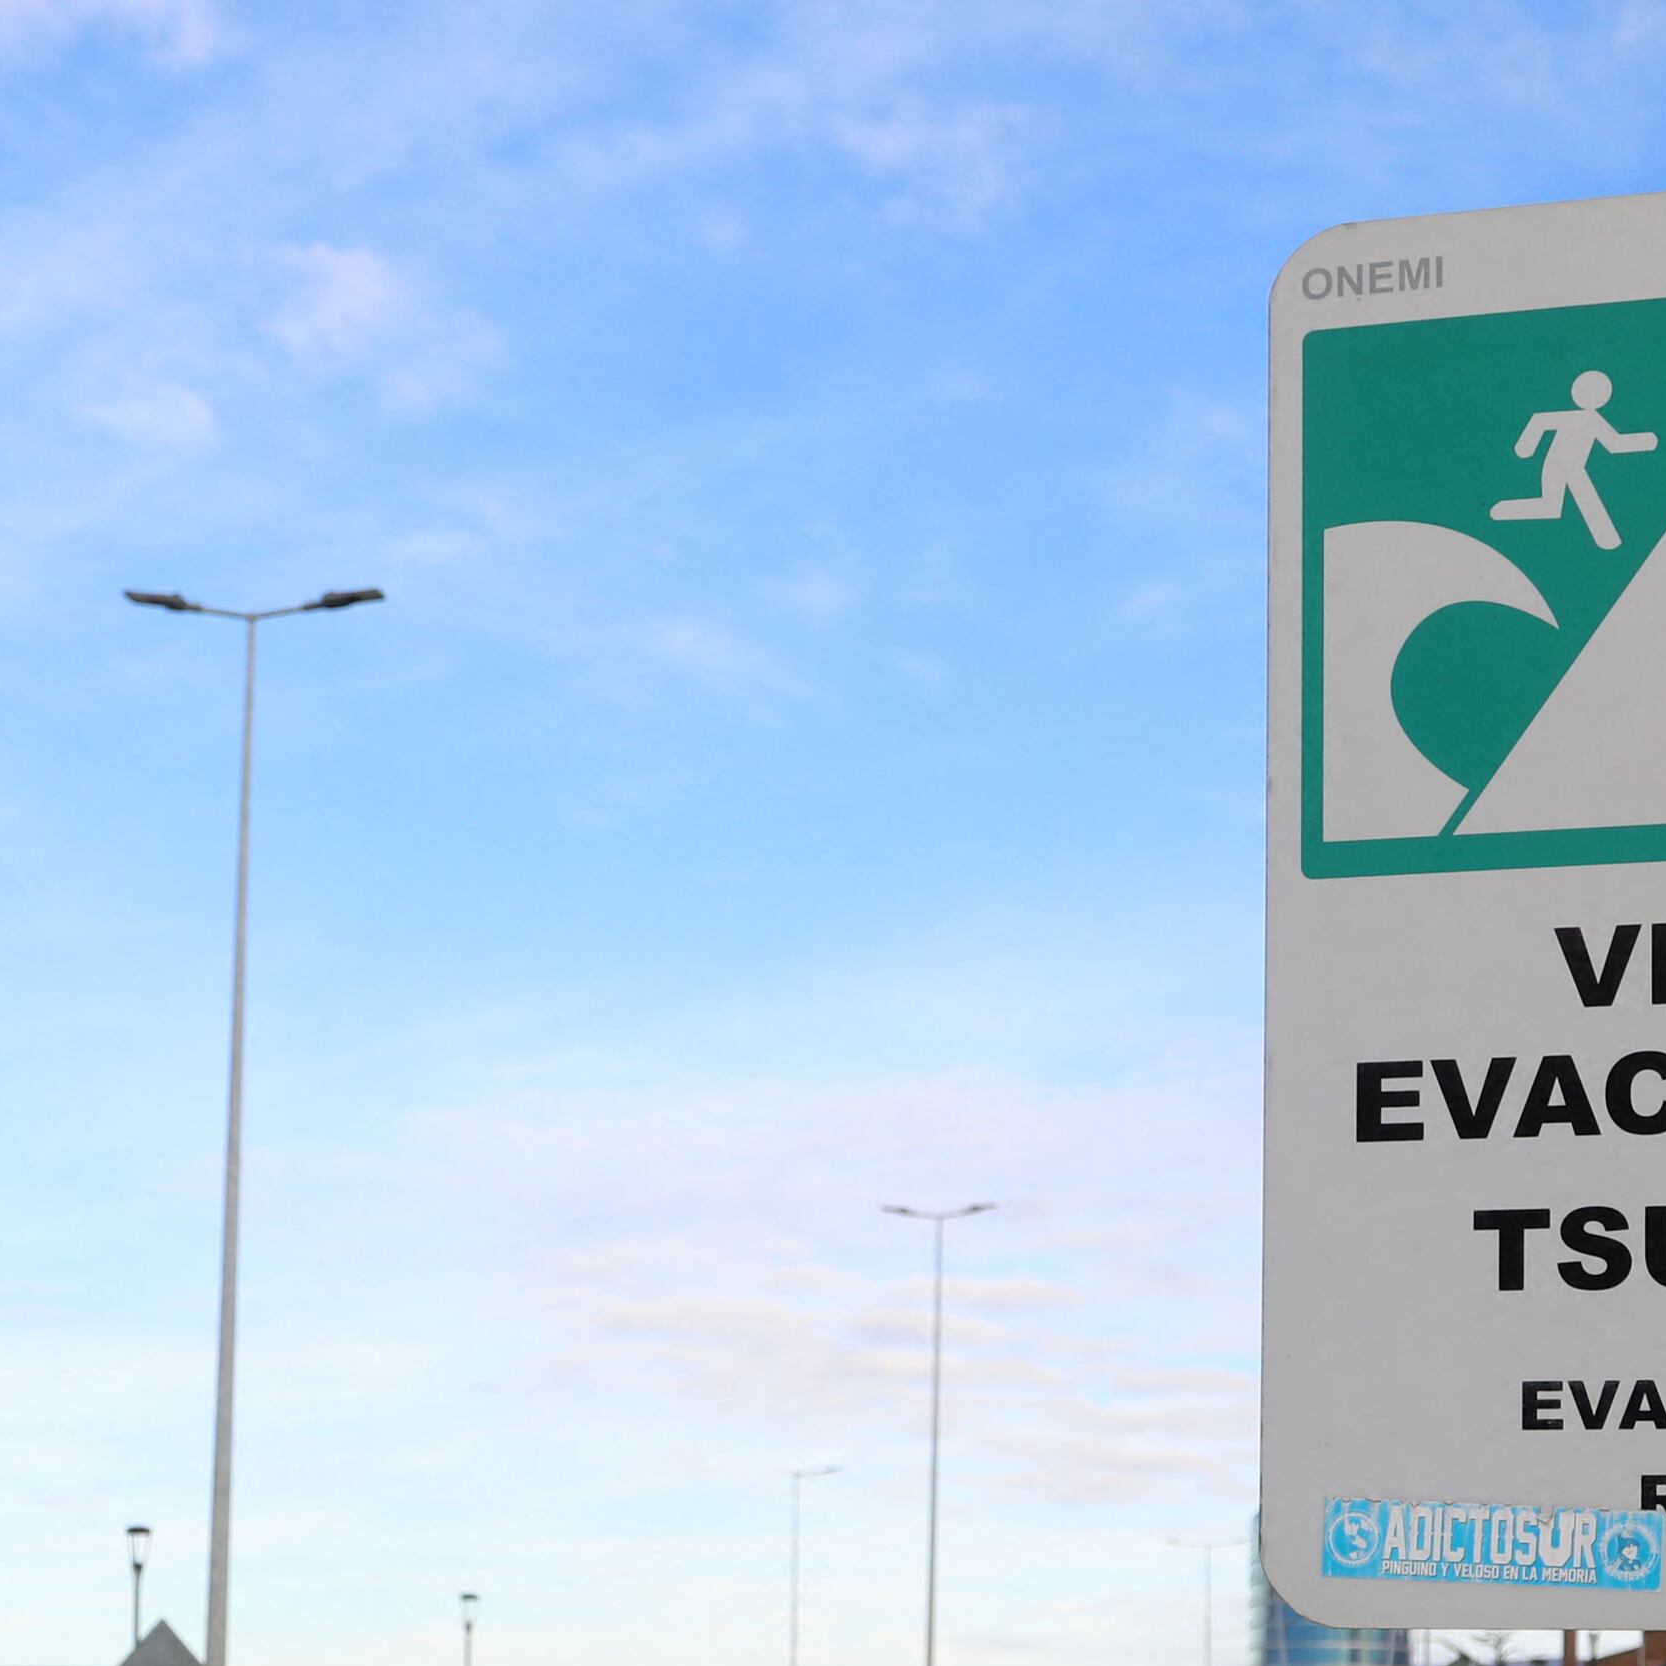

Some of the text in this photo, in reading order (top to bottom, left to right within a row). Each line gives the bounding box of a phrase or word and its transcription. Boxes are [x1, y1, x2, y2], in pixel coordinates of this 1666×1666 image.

[1301, 256, 1444, 301] ONEMI
[1383, 1505, 1598, 1569] ADICTOSUR
[1383, 1560, 1598, 1585] PINGUINO Y VELOSO EN LA MEMORIA
